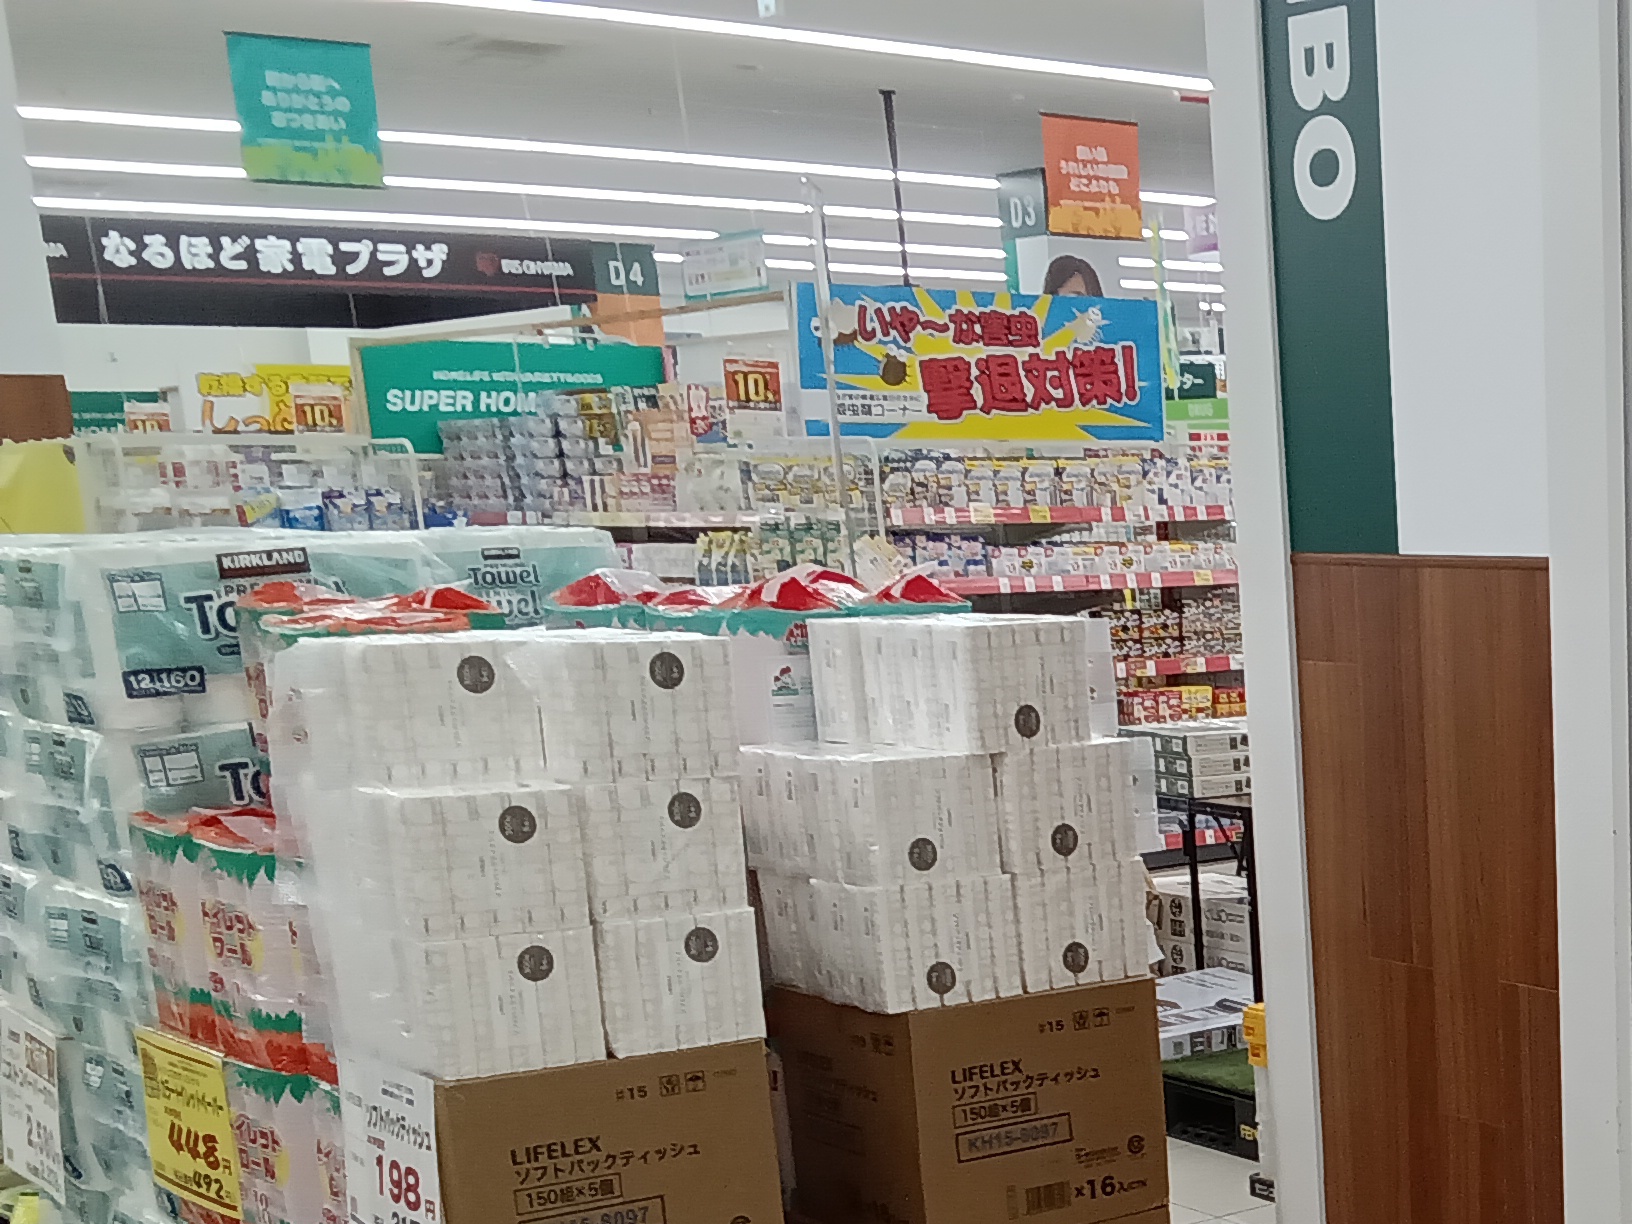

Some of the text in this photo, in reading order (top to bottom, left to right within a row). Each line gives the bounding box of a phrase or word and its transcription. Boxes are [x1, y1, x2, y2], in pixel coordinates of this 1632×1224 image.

[1287, 0, 1357, 221] BO
[1009, 196, 1036, 229] D3
[101, 230, 449, 278] なるほど家電プラザ
[386, 388, 475, 412] SUPER
[221, 550, 305, 570] KIRKLAND
[951, 1058, 1024, 1085] LIFELEX
[953, 1065, 1101, 1102] ソフトパックティッシュ
[231, 1113, 282, 1154] イレット
[511, 1135, 603, 1167] LIFELEX
[514, 1142, 701, 1186] ソフトパックティッシュ
